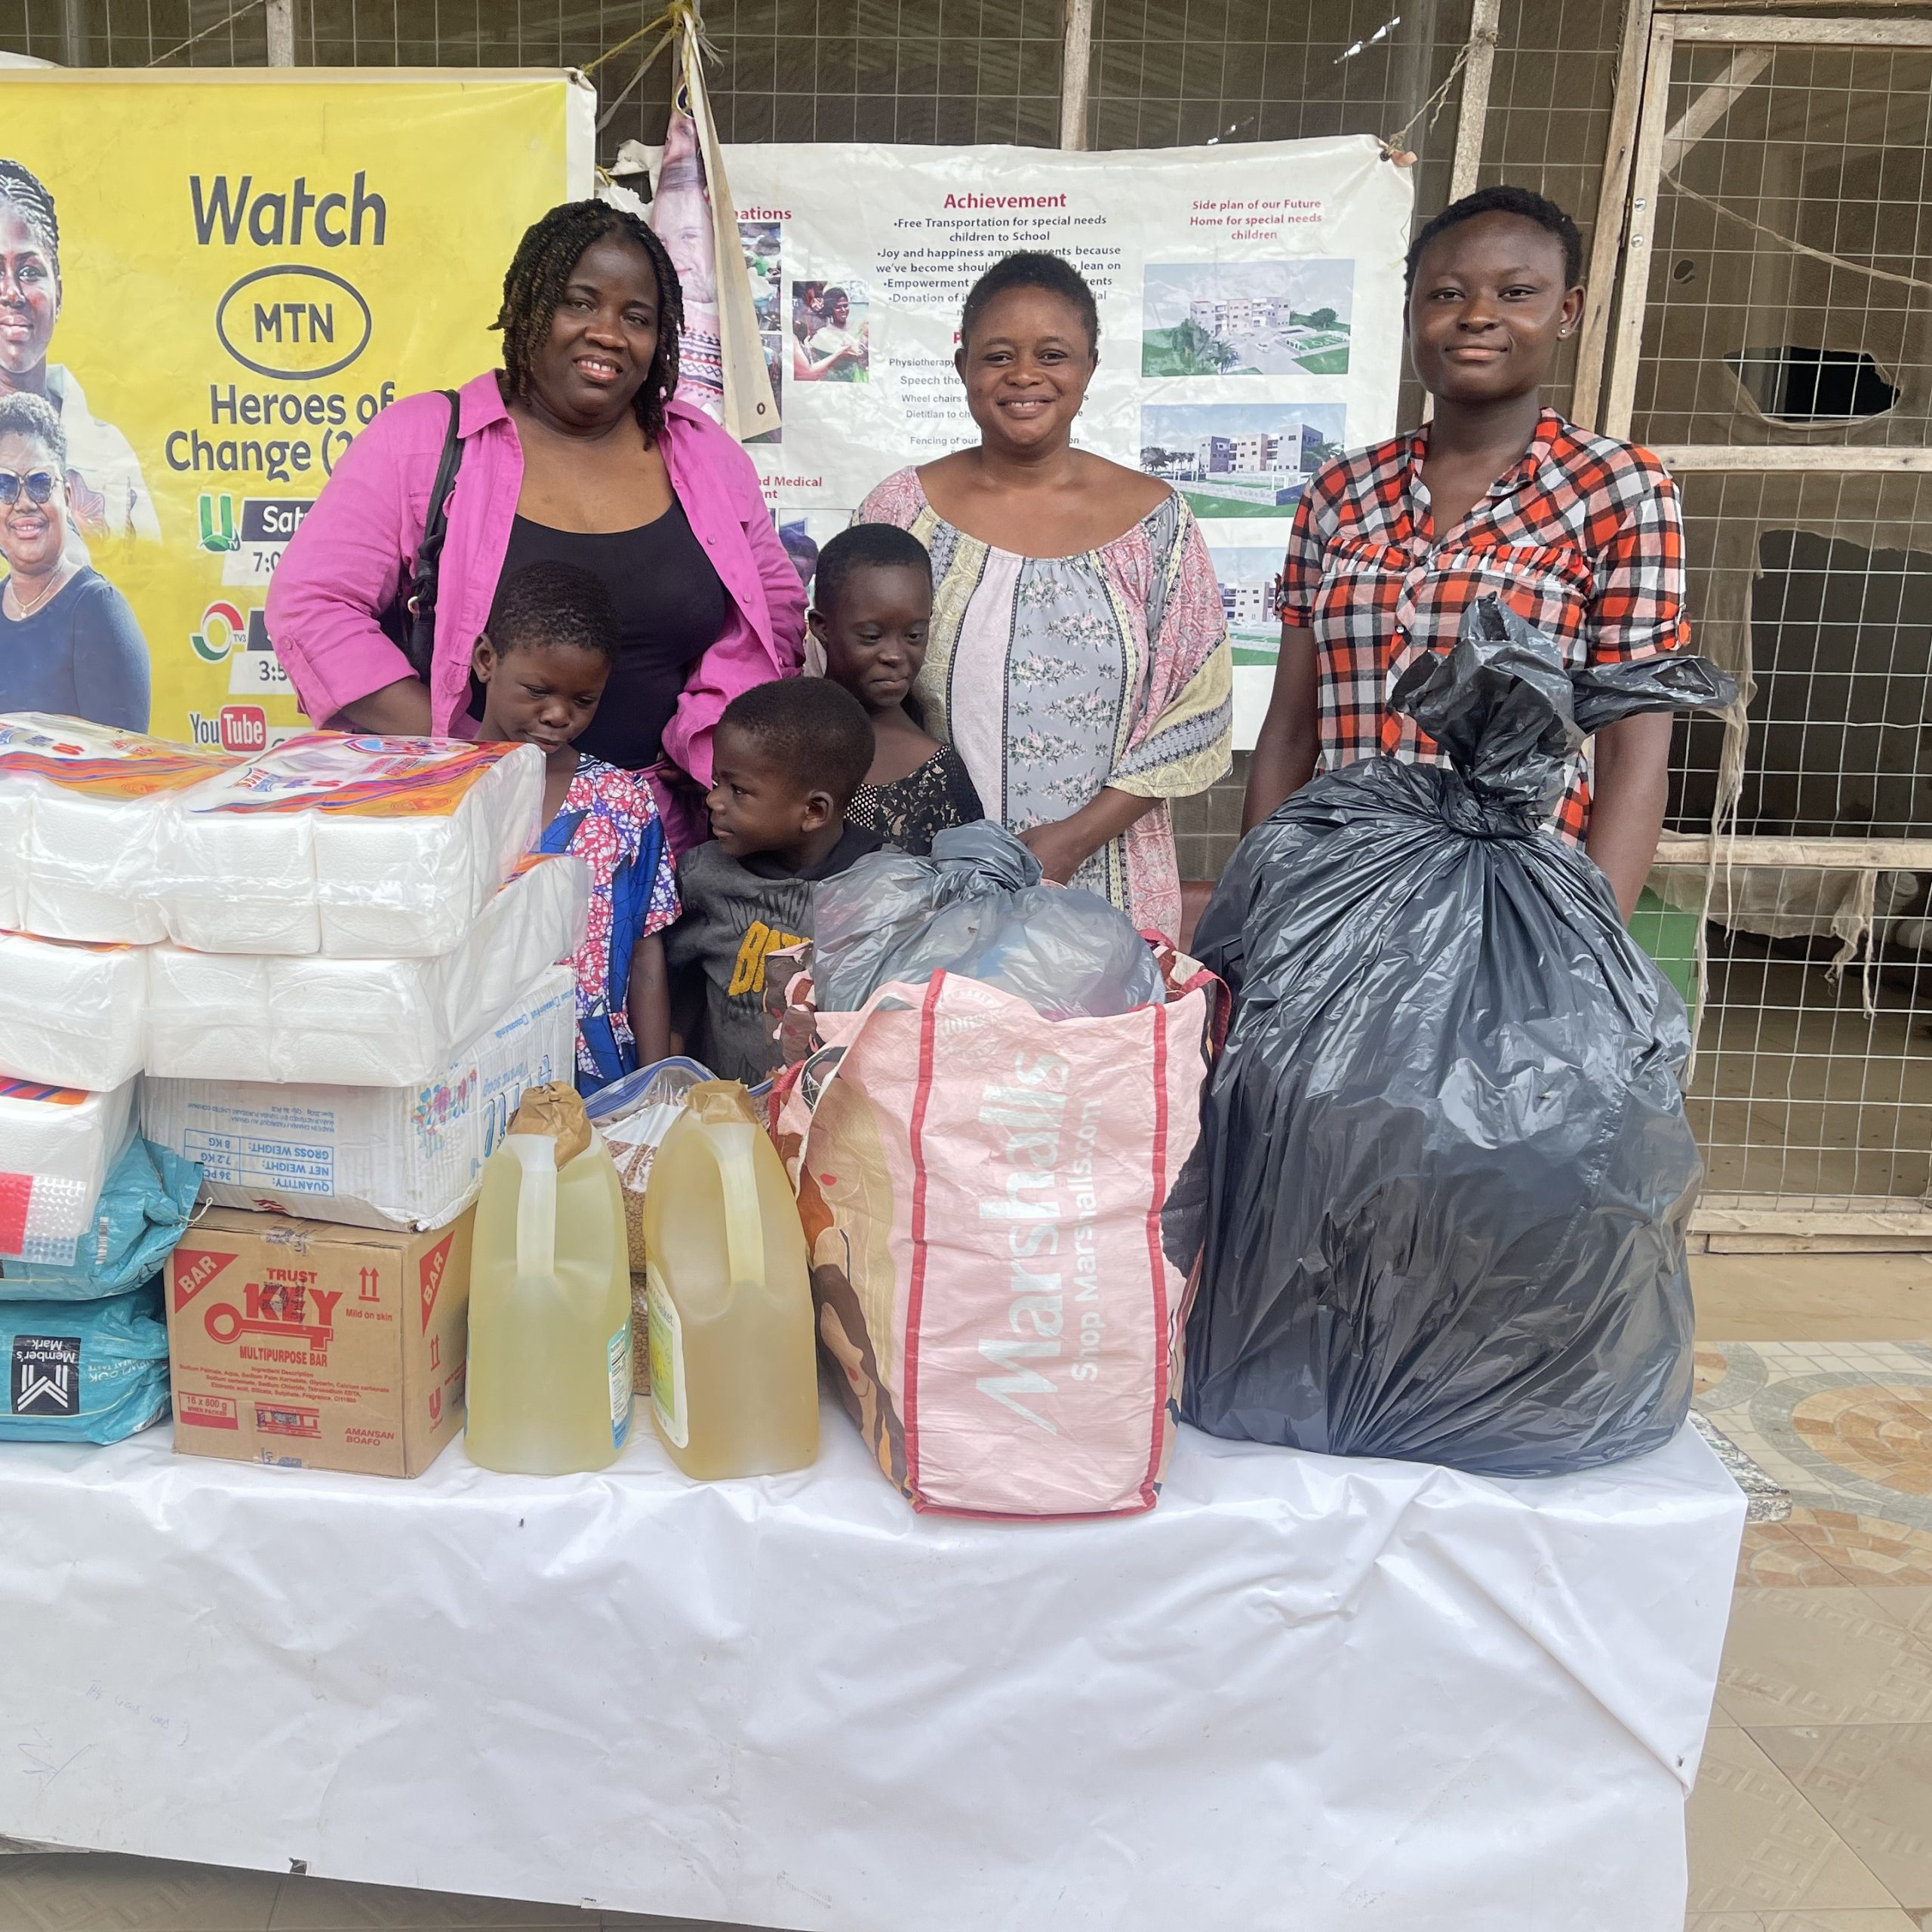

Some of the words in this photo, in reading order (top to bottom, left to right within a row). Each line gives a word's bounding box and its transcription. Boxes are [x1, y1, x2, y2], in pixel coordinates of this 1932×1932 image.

[943, 193, 1067, 209] Achievement
[1192, 200, 1217, 210] Side
[1220, 199, 1244, 212] plan
[1247, 198, 1260, 210] of
[1261, 201, 1281, 209] our
[1284, 198, 1322, 209] Future
[189, 170, 386, 248] Watch
[925, 217, 1010, 229] Transportation
[1013, 217, 1029, 227] for
[1032, 216, 1071, 228] special
[1073, 214, 1107, 226] needs
[1189, 216, 1223, 226] Home
[1226, 216, 1242, 226] for
[1245, 214, 1284, 227] special
[1287, 213, 1322, 223] needs
[949, 231, 995, 242] children
[998, 232, 1009, 242] to
[1012, 230, 1051, 242] School
[1231, 229, 1278, 240] children
[903, 248, 924, 258] and
[927, 247, 985, 260] happiness
[1075, 245, 1121, 256] because
[910, 262, 955, 273] become
[1081, 260, 1104, 271] lean
[1107, 263, 1121, 271] on
[947, 292, 958, 303] of
[254, 303, 334, 343] MTN
[888, 358, 955, 368] Physiotherapy
[900, 376, 940, 386] Speech
[209, 383, 347, 426] Heroes
[355, 380, 395, 424] of
[901, 394, 931, 403] Wheel
[933, 394, 962, 403] chairs
[910, 436, 948, 447] Fencing
[950, 436, 960, 445] of
[961, 437, 979, 445] our
[165, 428, 312, 482] Change
[774, 475, 823, 488] Medical
[233, 633, 248, 643] TV3
[189, 712, 264, 745] YouTube
[208, 1137, 223, 1149] KG
[224, 1140, 231, 1151] 8
[248, 1142, 291, 1156] WEIGHT:
[200, 1153, 215, 1164] KG
[217, 1154, 231, 1166] 7.2
[294, 1147, 329, 1161] GROSS
[261, 1160, 306, 1174] WEIGHT:
[309, 1164, 330, 1177] NET
[219, 1171, 231, 1181] 36
[272, 1177, 330, 1192] QUANTITY:
[1066, 1098, 1104, 1303] Marshalls.com
[974, 1051, 1069, 1436] Marshalls
[177, 1254, 218, 1295] BAR
[266, 1267, 318, 1284] TRUST
[423, 1251, 445, 1306] BAR
[242, 1281, 344, 1327] KEY
[345, 1308, 363, 1318] Mild
[364, 1310, 375, 1320] on
[376, 1311, 393, 1322] skin
[30, 1338, 63, 1351] Mark
[1070, 1311, 1107, 1383] Shop
[15, 1349, 76, 1364] Member's
[239, 1346, 308, 1365] MULTIPURPOSE
[309, 1352, 328, 1368] BAR
[198, 1398, 204, 1406] x
[221, 1401, 227, 1411] g
[344, 1427, 395, 1440] AMANSAN
[345, 1435, 381, 1447] BOAFO
